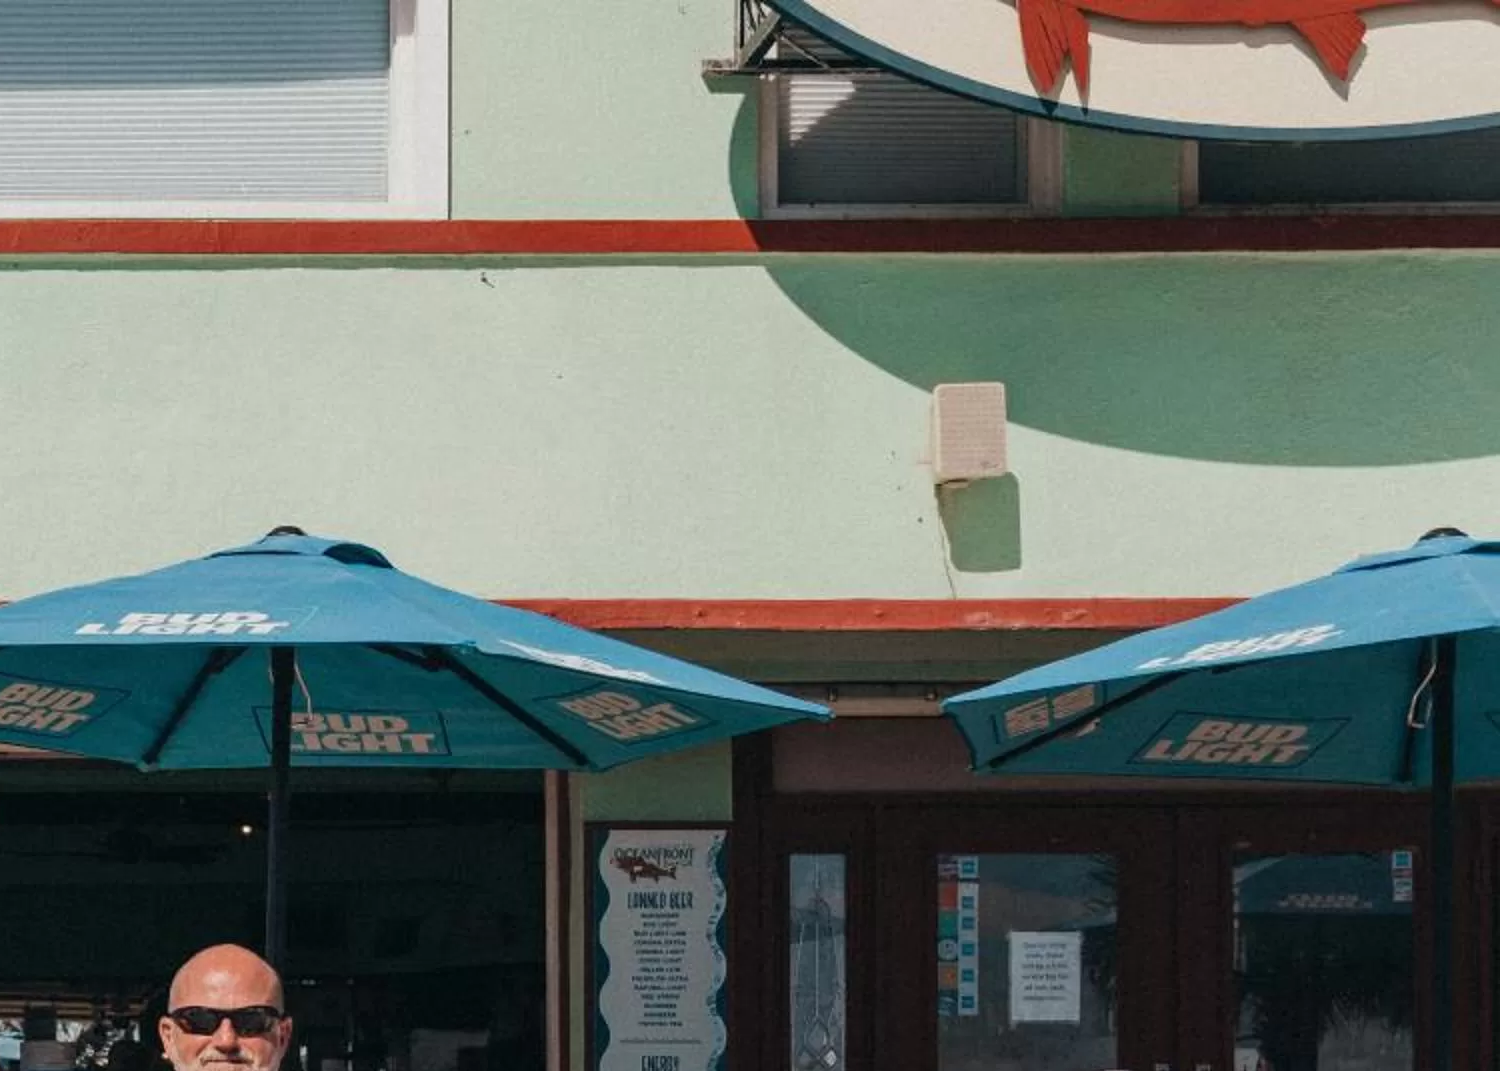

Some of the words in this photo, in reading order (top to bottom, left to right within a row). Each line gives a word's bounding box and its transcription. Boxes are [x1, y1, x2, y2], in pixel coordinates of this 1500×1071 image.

[74, 621, 292, 636] LIGHT
[119, 611, 270, 625] BUD
[557, 691, 642, 720] BUD
[291, 711, 409, 733] BUD
[1185, 719, 1309, 743] BUD
[1143, 739, 1310, 764] LIGHT
